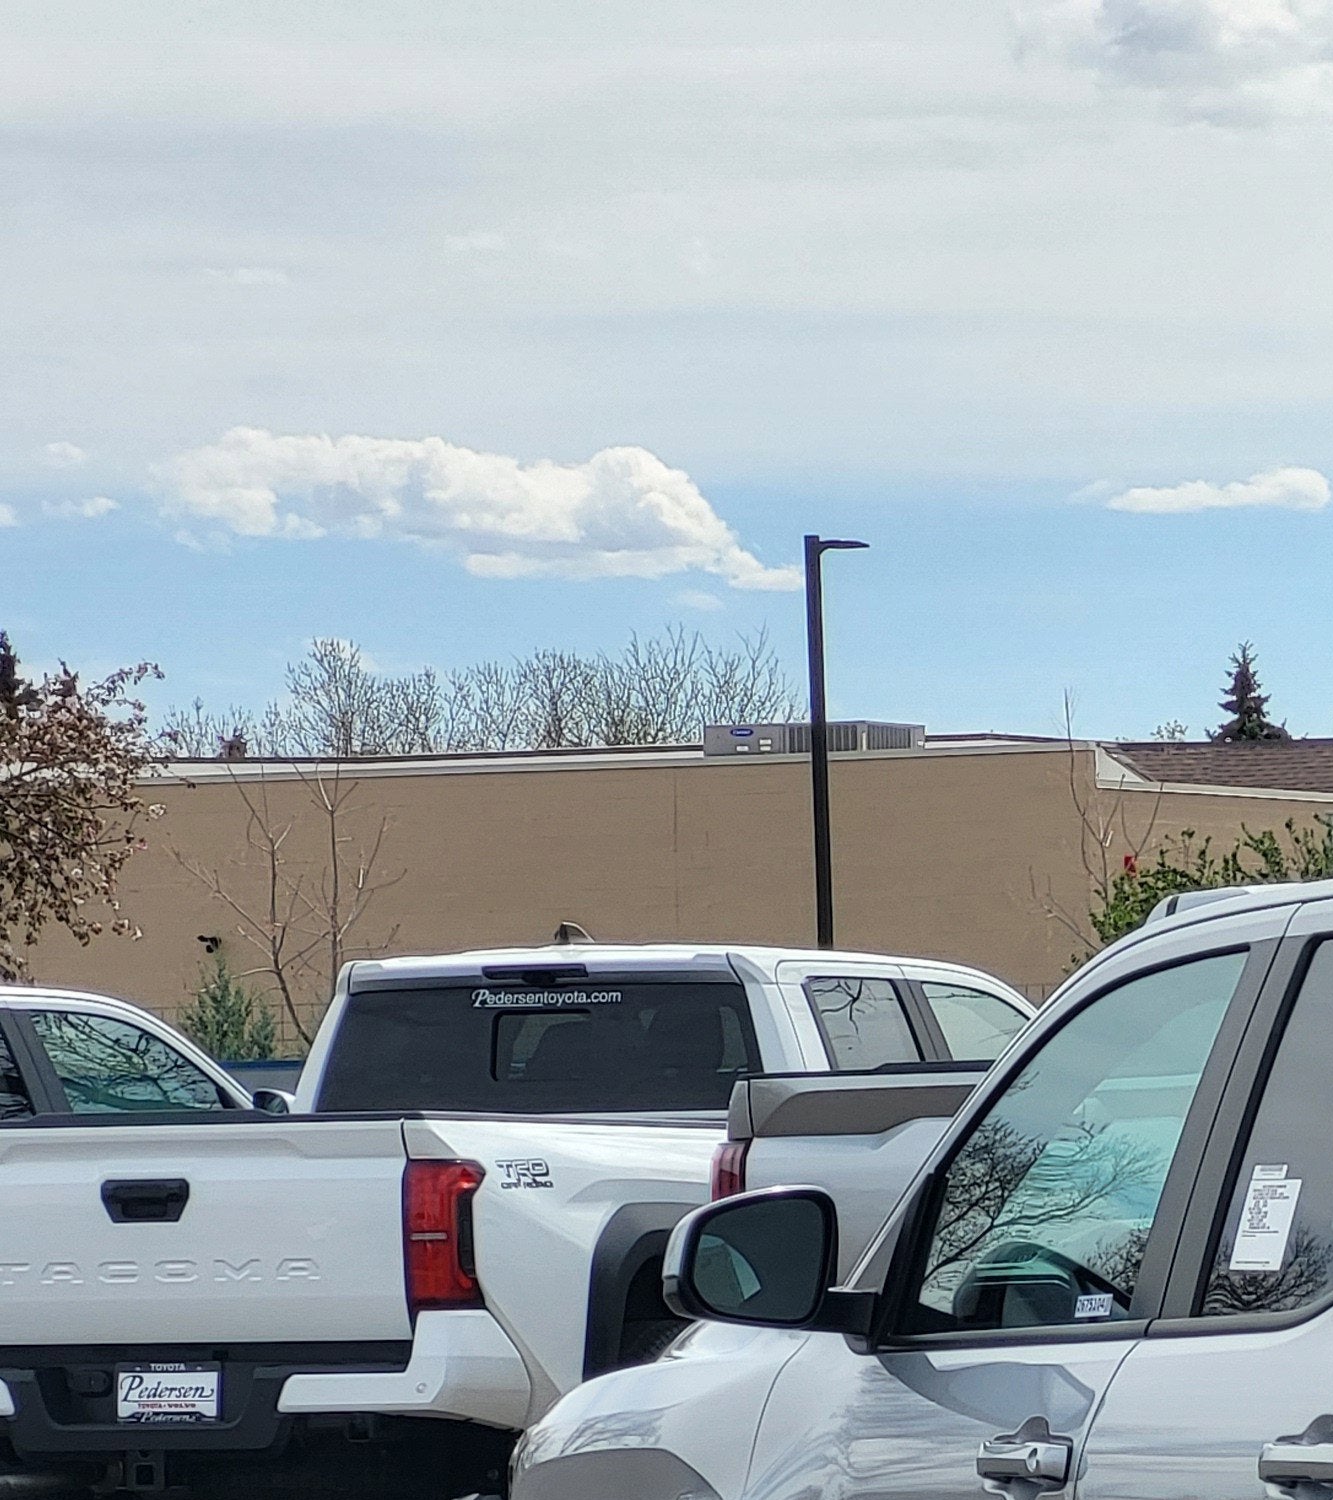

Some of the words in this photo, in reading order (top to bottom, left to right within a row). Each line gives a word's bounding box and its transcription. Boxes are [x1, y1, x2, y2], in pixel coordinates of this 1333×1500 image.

[471, 989, 622, 1008] Pedersentoyota.com
[149, 1363, 186, 1372] TOYOTA
[120, 1374, 214, 1402] Pedersen
